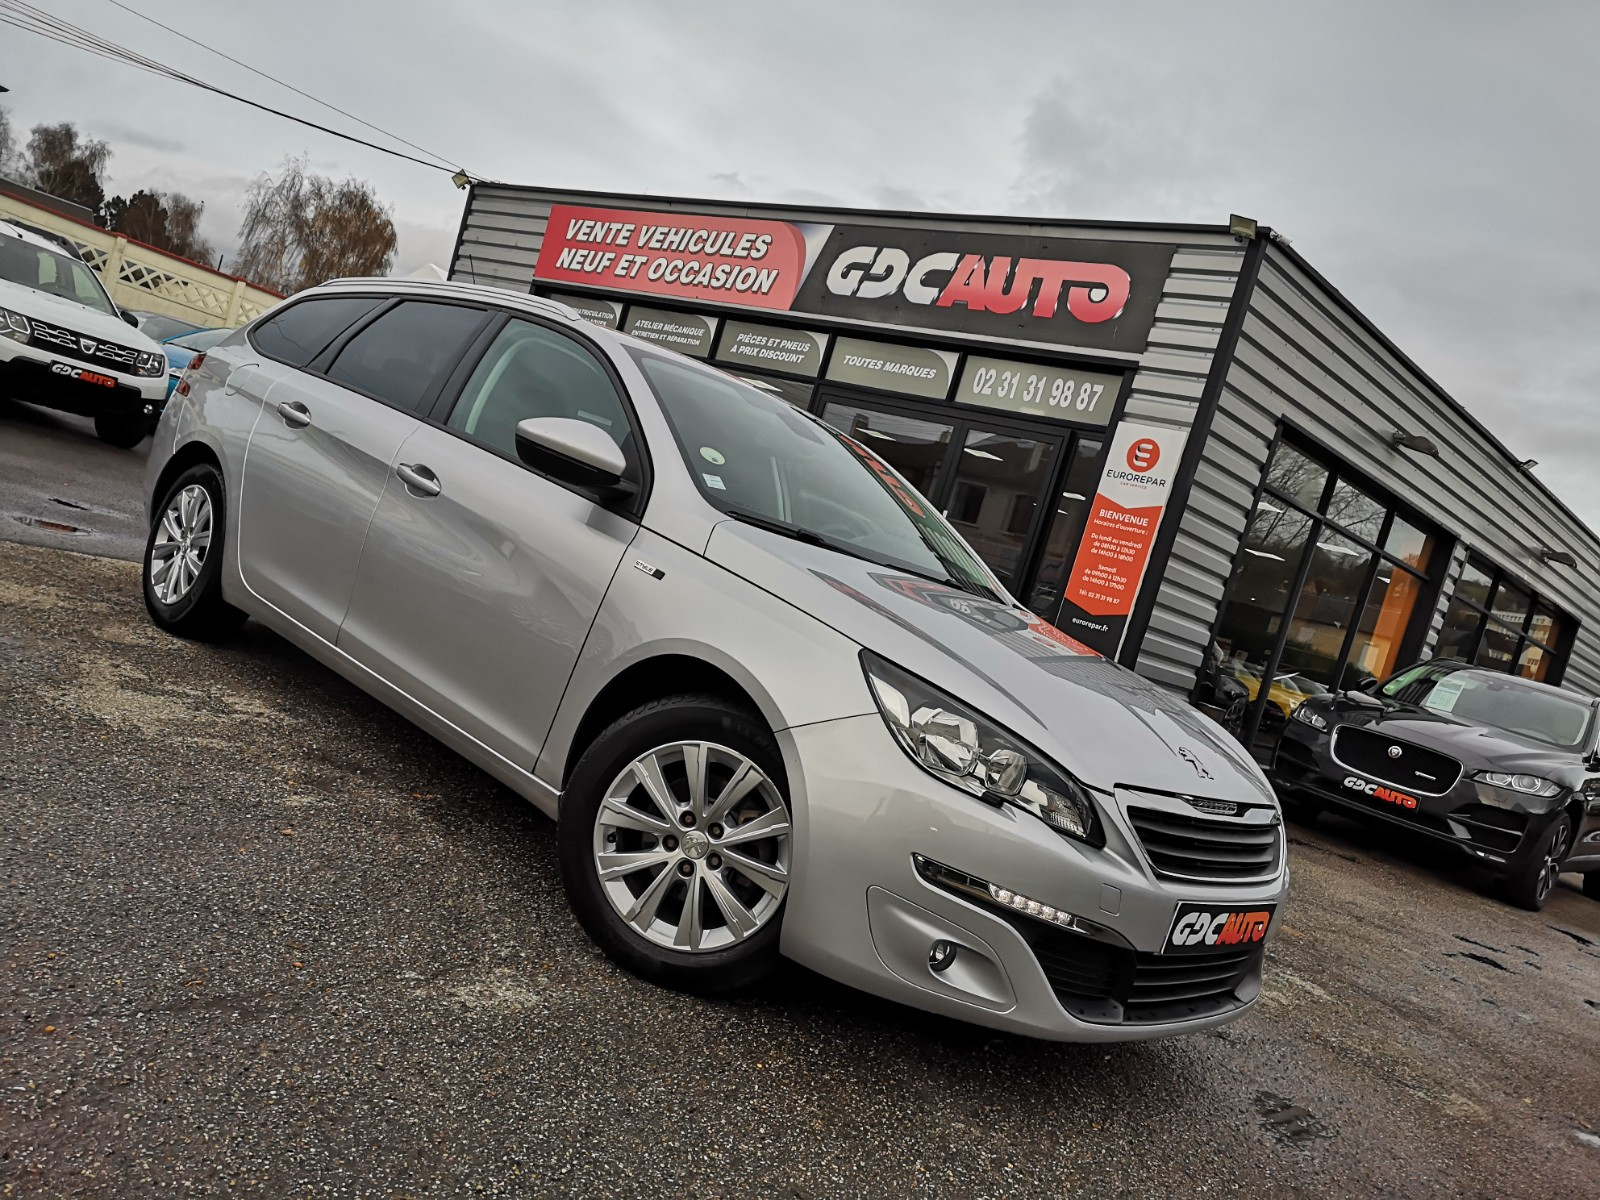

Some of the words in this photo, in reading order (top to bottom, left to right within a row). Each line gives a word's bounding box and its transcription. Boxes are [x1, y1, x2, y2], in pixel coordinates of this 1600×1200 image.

[565, 218, 636, 246] VENTE
[639, 225, 772, 260] VEHICULES
[555, 247, 615, 274] NEUF
[613, 254, 648, 279] ET
[647, 257, 779, 295] OCCASION
[634, 319, 664, 331] ATELIER
[662, 322, 706, 337] MÉCANIQUE
[631, 329, 660, 340] ENTRETIEN
[659, 333, 668, 341] ET
[667, 334, 701, 346] RÉPARATION
[736, 332, 768, 345] PIÈCES
[766, 338, 781, 348] ET
[779, 340, 811, 352] PNEUS
[730, 344, 738, 353] A
[737, 345, 760, 357] PRIX
[758, 348, 805, 363] DISCOUNT
[843, 355, 884, 371] TOUTES
[882, 360, 937, 380] MARQUES
[972, 367, 995, 396] 02
[997, 368, 1021, 399] 31
[1023, 374, 1047, 403] 31
[1048, 378, 1074, 408] 98
[1075, 381, 1105, 412] 87
[1106, 469, 1166, 487] EUROREPAR
[1093, 518, 1115, 528] Horaires
[1099, 508, 1149, 527] BIENVENUE
[1099, 534, 1113, 542] lundi
[1119, 539, 1143, 549] vendredi
[1098, 549, 1114, 557] 14h00
[1098, 564, 1117, 573] Samedi
[1089, 577, 1105, 586] 14h00
[1109, 582, 1125, 591] 17h00
[1072, 617, 1109, 632] eurorepar.fr
